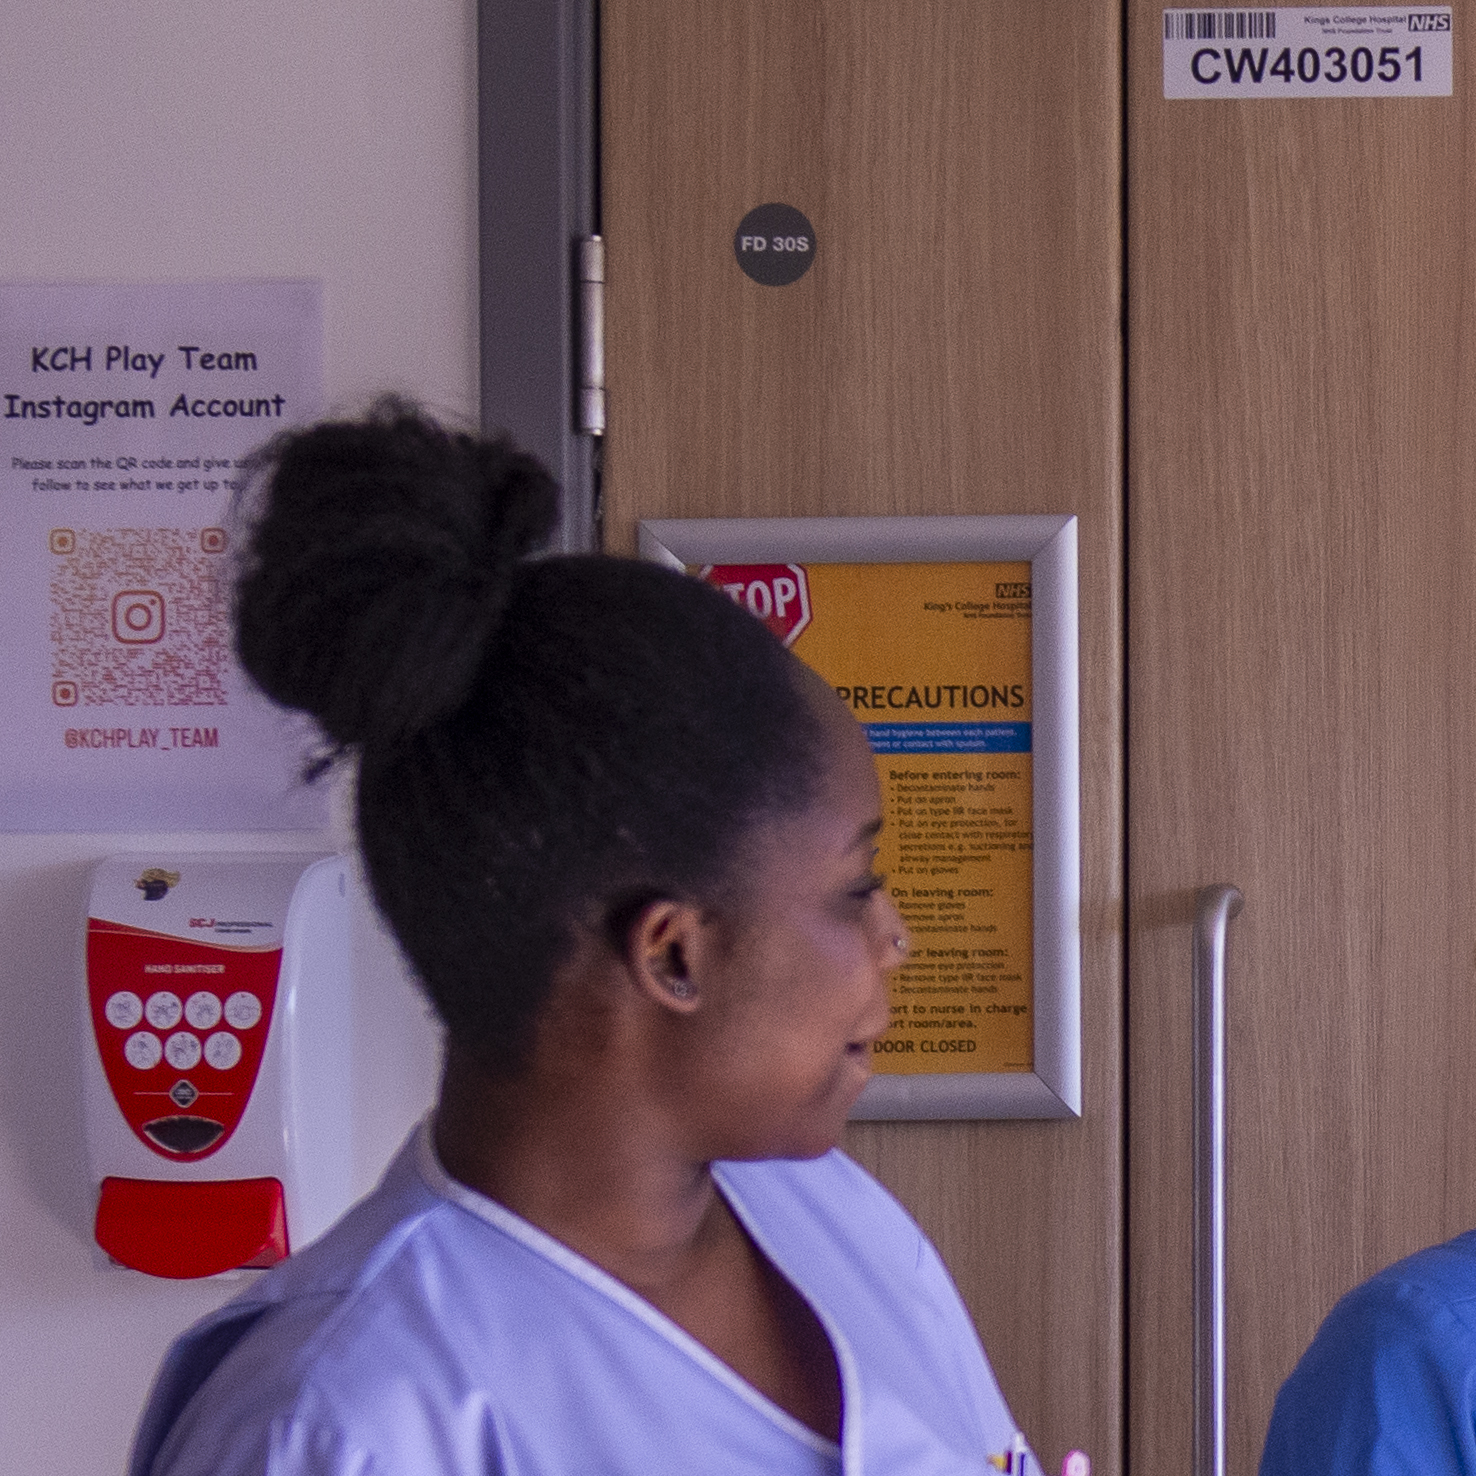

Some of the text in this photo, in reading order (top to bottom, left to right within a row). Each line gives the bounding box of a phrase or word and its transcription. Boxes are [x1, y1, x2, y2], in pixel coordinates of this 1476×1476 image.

[1333, 15, 1367, 25] College
[1369, 15, 1407, 25] Hospital
[1409, 14, 1450, 31] NHS
[1190, 46, 1422, 84] CW403051
[742, 236, 809, 252] FD 30S
[31, 345, 258, 379] KCH Play Team
[4, 393, 286, 426] Instagram Account
[11, 457, 52, 470] Please
[57, 460, 86, 470] scan
[91, 457, 113, 470] the
[116, 457, 138, 471] QR
[142, 457, 172, 469] code
[177, 457, 200, 469] and
[203, 457, 230, 472] give
[32, 479, 71, 491] follow
[77, 480, 90, 491] to
[94, 481, 115, 491] see
[120, 479, 151, 491] what
[155, 481, 174, 491] we
[177, 480, 199, 493] get
[203, 481, 219, 493] up
[723, 577, 1031, 619] TOP NHS
[955, 602, 989, 612] College
[836, 686, 1025, 709] PRECAUTIONS
[64, 727, 219, 750] @KCHPLAY_TEAM
[889, 770, 1020, 781] Before entering room:
[897, 807, 912, 815] Put
[899, 820, 913, 828] Put
[930, 867, 959, 875] gloves
[891, 888, 994, 899] On leaving room:
[926, 949, 969, 959] leaving
[972, 949, 1009, 957] room:
[913, 1005, 926, 1014] to
[930, 1005, 965, 1014] nurse
[970, 1004, 981, 1013] in
[985, 1004, 1027, 1016] charge
[874, 1040, 976, 1053] DOOR CLOSED
